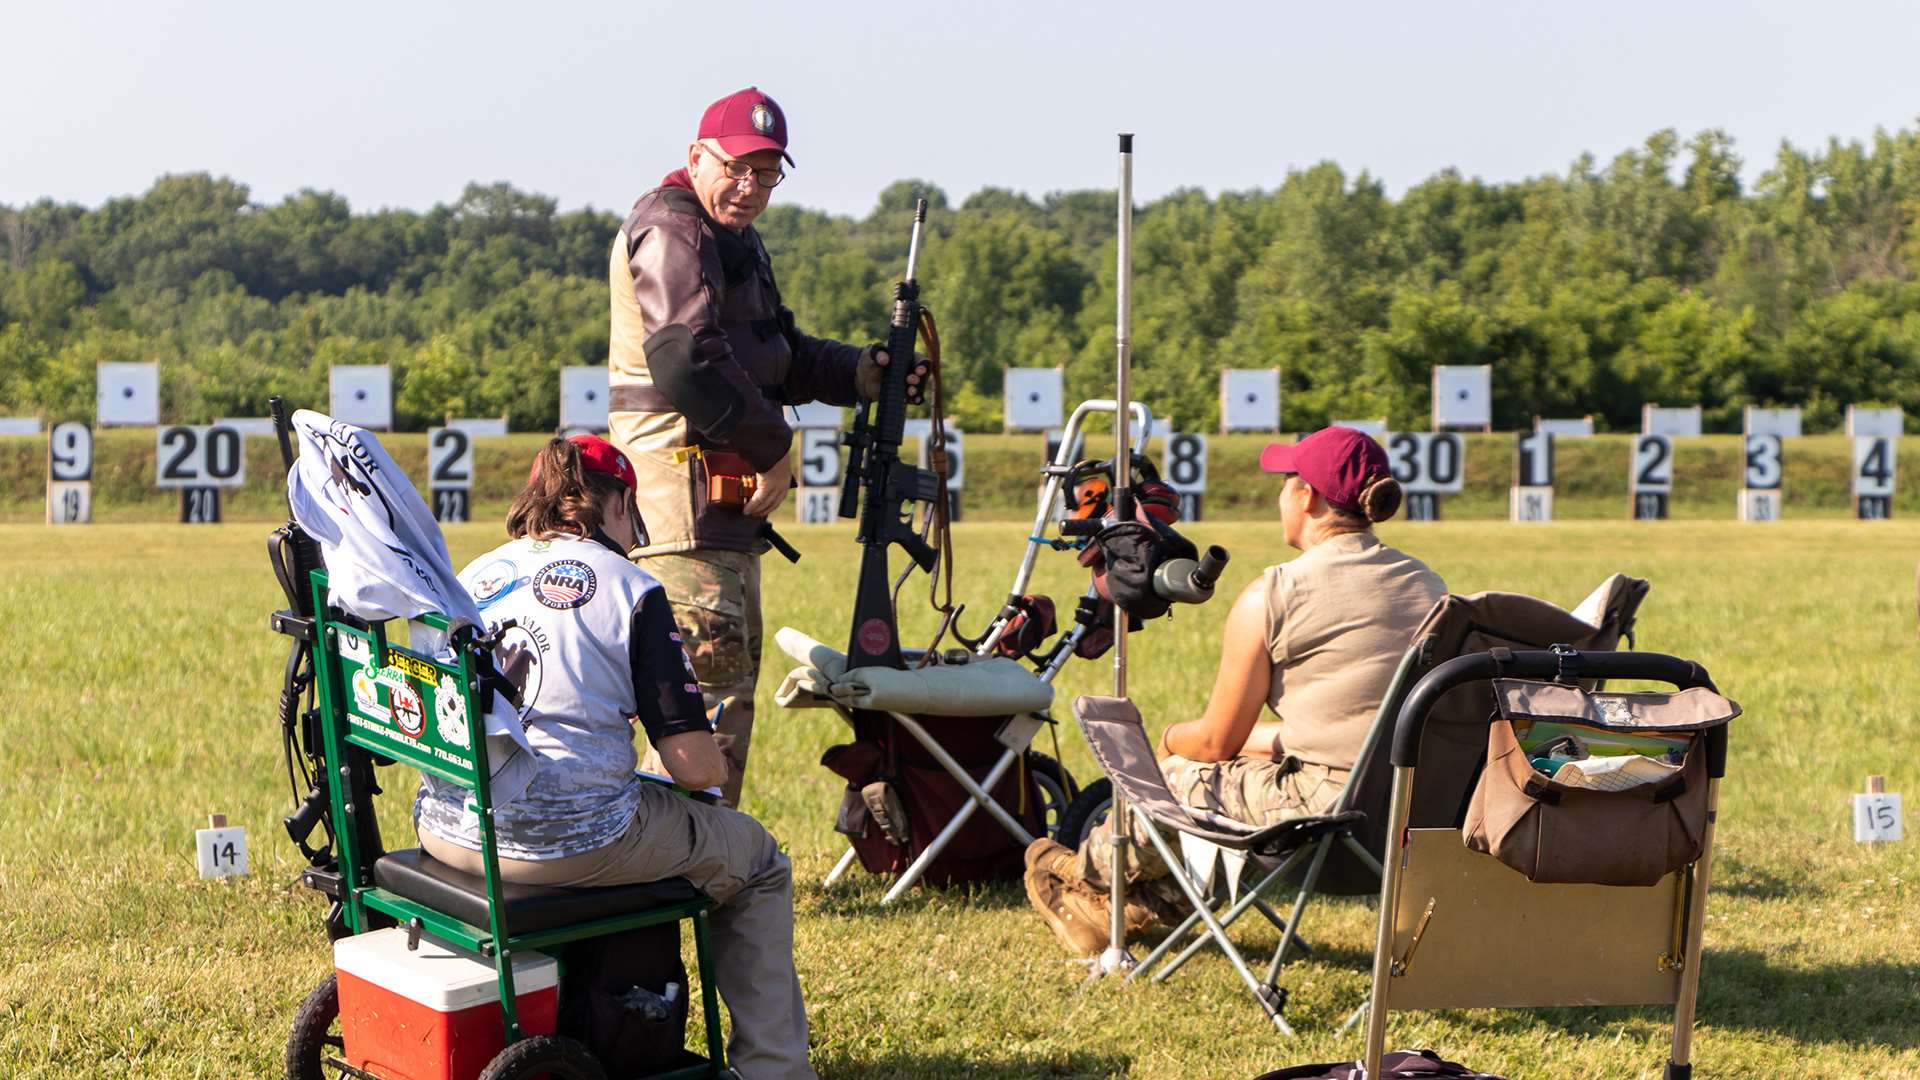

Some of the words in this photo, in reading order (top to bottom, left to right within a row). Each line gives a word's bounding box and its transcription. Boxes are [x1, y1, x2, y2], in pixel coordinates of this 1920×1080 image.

[53, 422, 91, 480] 9
[163, 426, 240, 479] 20
[434, 429, 468, 481] 2
[803, 429, 840, 485] 5
[1169, 435, 1201, 485] 8
[1389, 434, 1459, 484] 30
[1522, 435, 1550, 485] 1
[1638, 437, 1670, 484] 2
[1747, 436, 1782, 487] 3
[1860, 438, 1891, 487] 4
[63, 488, 80, 521] 19
[189, 489, 214, 522] 20
[439, 490, 463, 522] 22
[543, 574, 584, 593] NRA
[522, 615, 551, 654] VALOR
[387, 648, 438, 684] BERGER
[1867, 806, 1895, 830] 15
[213, 842, 241, 867] 14
